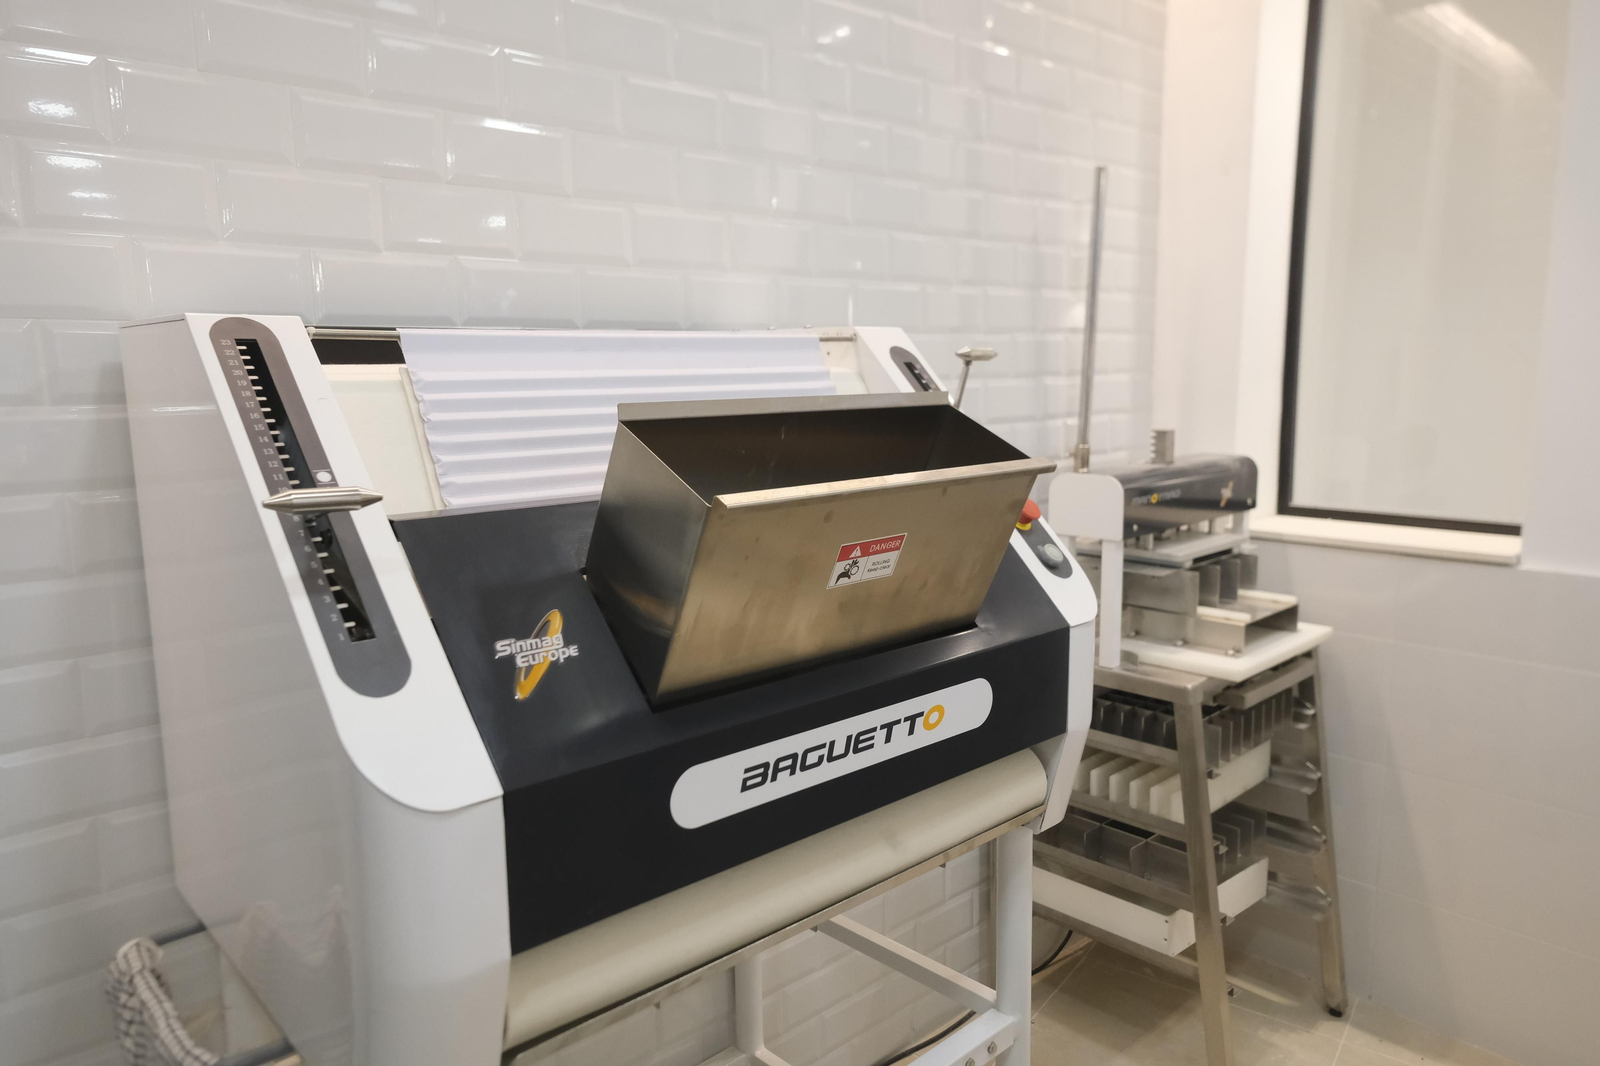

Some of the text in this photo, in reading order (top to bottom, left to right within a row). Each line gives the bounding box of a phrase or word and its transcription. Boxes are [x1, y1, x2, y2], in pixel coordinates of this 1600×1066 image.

[870, 540, 901, 552] DANGER
[317, 578, 324, 586] 4
[323, 596, 331, 604] 3
[330, 614, 338, 622] 2
[495, 634, 564, 659] Sinmag
[516, 645, 579, 668] Europe
[740, 704, 945, 793] BAGUETTO
